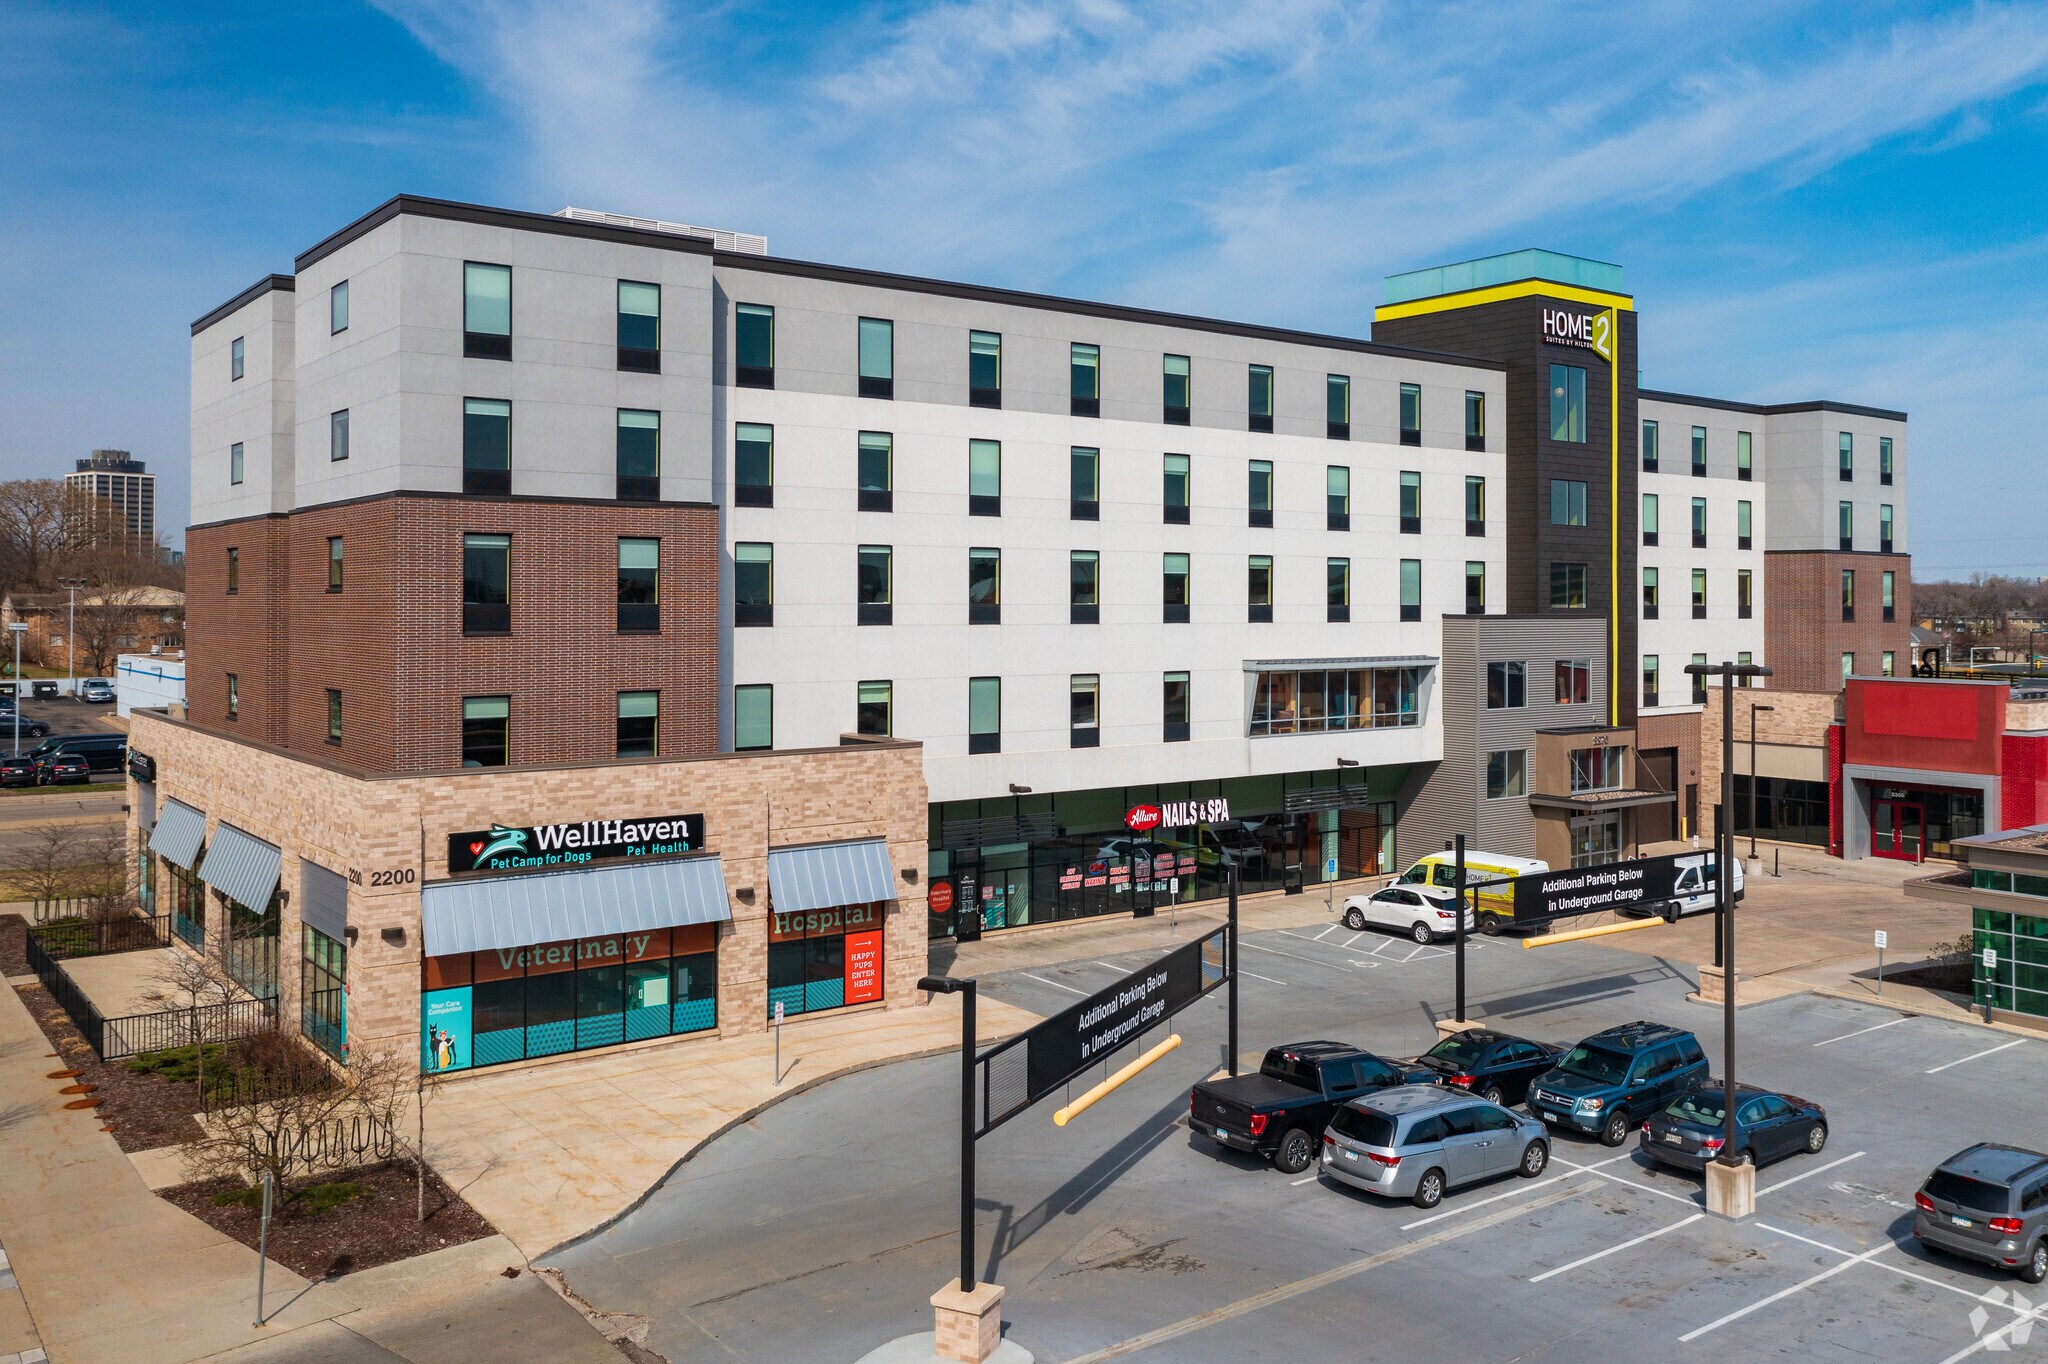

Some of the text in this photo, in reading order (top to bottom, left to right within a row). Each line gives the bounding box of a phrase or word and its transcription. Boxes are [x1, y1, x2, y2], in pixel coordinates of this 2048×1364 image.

[1543, 308, 1593, 340] HOME
[1546, 336, 1593, 348] SUITES BY HILTON
[1130, 798, 1229, 828] Allure NAILS & SPA
[533, 819, 689, 850] WellHaven
[627, 841, 689, 857] Pet Health
[491, 851, 592, 869] Pet Camp for Dogs
[371, 868, 415, 887] 2200
[1542, 869, 1643, 893] Additional Parking Below
[1548, 887, 1643, 912] in Underground Garage
[775, 904, 873, 934] Hospital
[497, 935, 650, 970] Veterinary
[851, 951, 875, 961] HAPPY
[851, 969, 875, 979] ENTER
[854, 961, 873, 970] PUPS
[854, 979, 873, 988] HERE
[428, 1006, 463, 1015] Companion
[1078, 971, 1168, 1032] Additional Parking Below
[1082, 999, 1165, 1058] in Underground Garage
